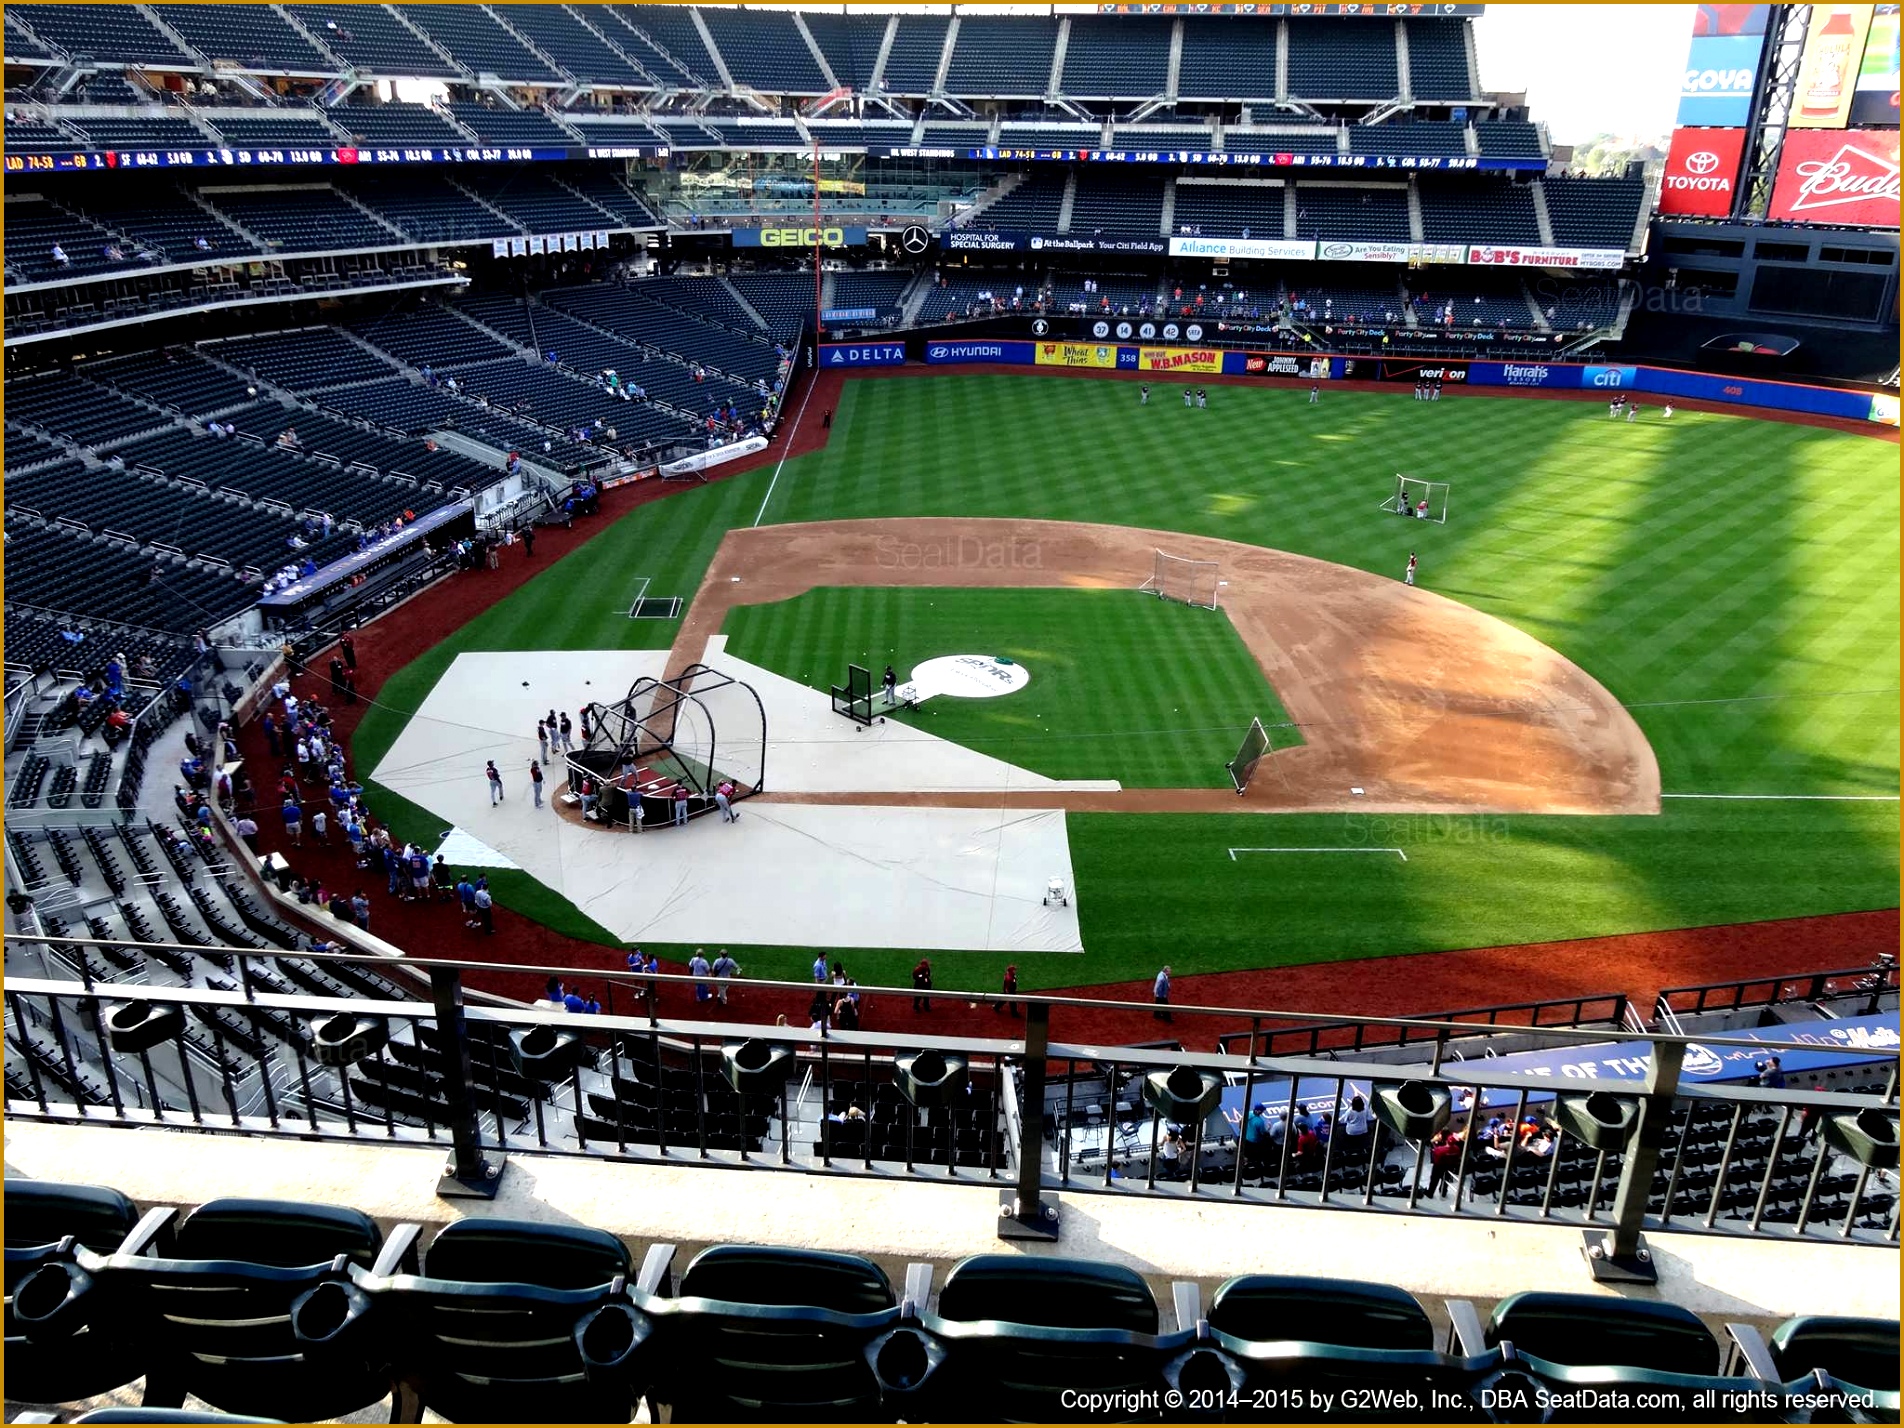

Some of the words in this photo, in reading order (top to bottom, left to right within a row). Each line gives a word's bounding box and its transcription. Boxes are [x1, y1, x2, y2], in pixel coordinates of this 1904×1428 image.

[1683, 69, 1753, 92] GOYA
[900, 149, 918, 157] WEST
[919, 149, 955, 157] STANDINGS
[998, 150, 1012, 158] LAD
[6, 156, 24, 169] LAD
[27, 156, 54, 169] 74-58
[74, 155, 87, 168] GB
[1667, 176, 1730, 191] TOYOTA
[761, 228, 844, 247] GEICO
[950, 233, 983, 243] HOSPITAL
[950, 241, 979, 249] SPECIAL
[981, 242, 1015, 251] SURGERY
[1065, 240, 1095, 250] Ballpark
[1098, 242, 1115, 250] Your
[1116, 242, 1130, 250] Citi
[1131, 242, 1147, 250] Field
[1148, 243, 1164, 252] App
[1179, 241, 1227, 254] Alliance
[1229, 245, 1265, 256] Building
[1267, 247, 1306, 257] Services
[1382, 246, 1405, 255] Eating
[1364, 252, 1397, 261] Sensibly?
[1470, 249, 1520, 264] BOB'S
[1522, 255, 1579, 266] FURNITURE
[1096, 326, 1106, 335] 37
[1120, 326, 1129, 335] 14
[1143, 327, 1152, 335] 41
[1165, 328, 1175, 336] 42
[1225, 324, 1242, 332] Party
[1243, 325, 1255, 333] City
[1338, 328, 1355, 336] Party
[1356, 329, 1368, 337] City
[1446, 332, 1463, 340] Party
[1464, 333, 1477, 341] City
[850, 348, 903, 361] DELTA
[951, 346, 1001, 357] HYUNDAI
[1063, 345, 1089, 357] Wheat
[1063, 355, 1088, 366] Thins
[1120, 354, 1136, 363] 358
[1272, 356, 1297, 366] JOHNNY
[1246, 358, 1265, 371] New
[1267, 361, 1299, 374] APPLESEED
[1419, 367, 1466, 381] verizon
[1503, 363, 1549, 379] Harrah's
[1594, 372, 1622, 387] citi
[1723, 386, 1742, 396] 408
[1561, 1062, 1598, 1079] OF
